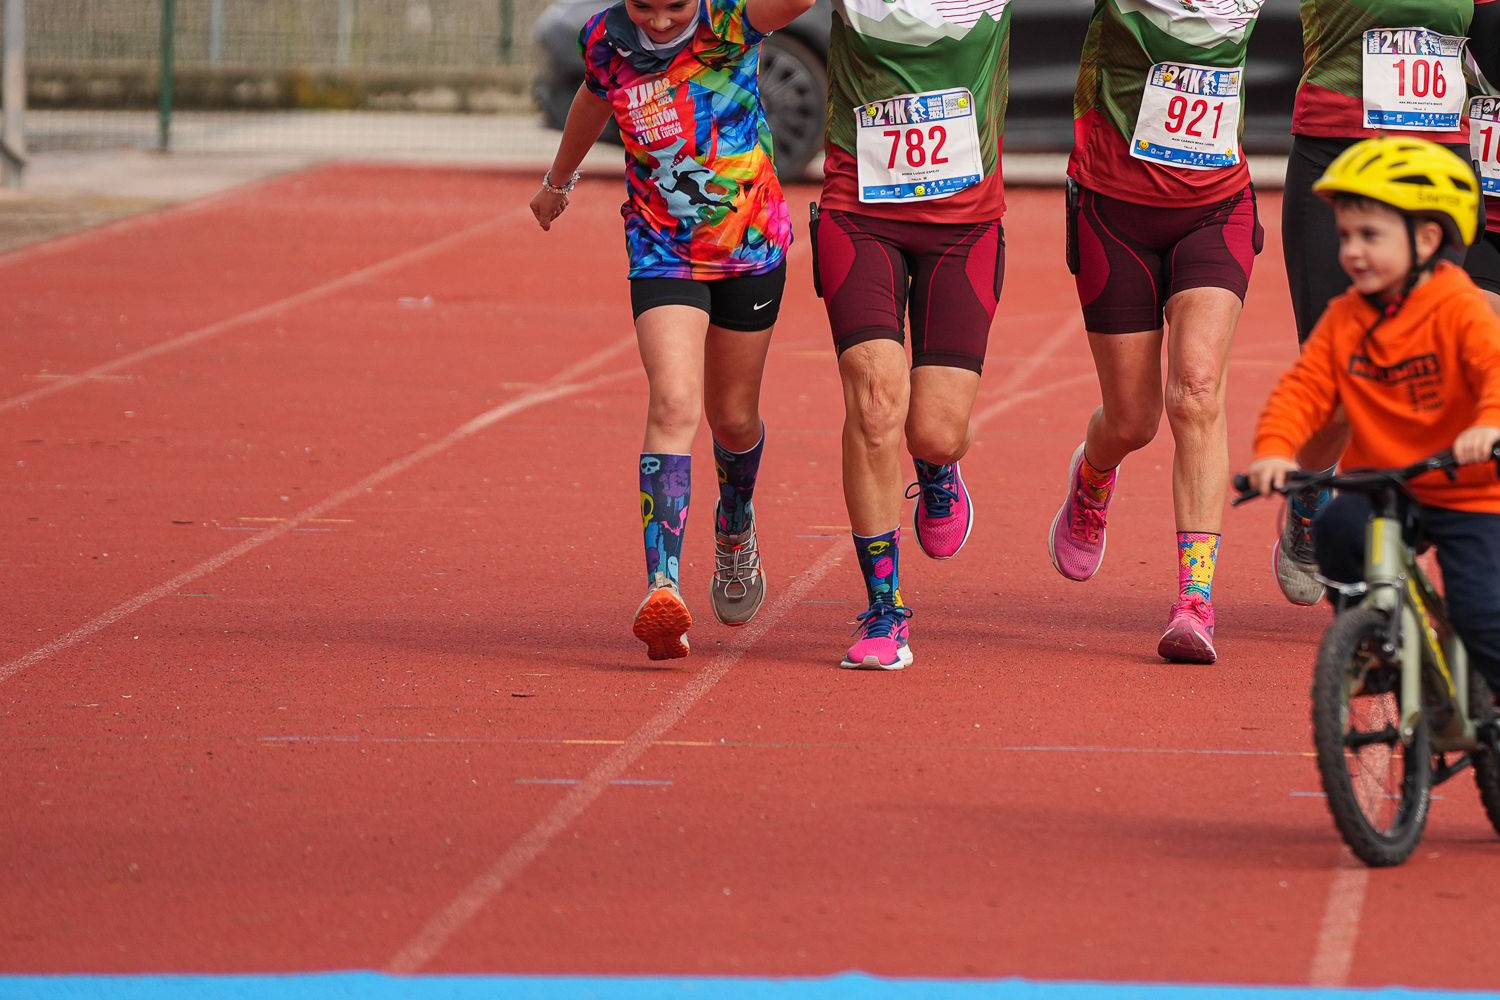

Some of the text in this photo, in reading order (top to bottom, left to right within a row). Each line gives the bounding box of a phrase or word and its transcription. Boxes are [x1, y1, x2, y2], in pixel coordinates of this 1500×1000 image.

[1381, 31, 1417, 54] 21K
[1165, 65, 1203, 94] 21K
[1392, 59, 1447, 99] 106
[633, 107, 678, 132] MARATÓN
[874, 100, 908, 126] 21K
[1165, 95, 1224, 139] 921
[642, 128, 661, 144] 10K
[661, 126, 683, 139] LUCENA
[883, 125, 949, 169] 782
